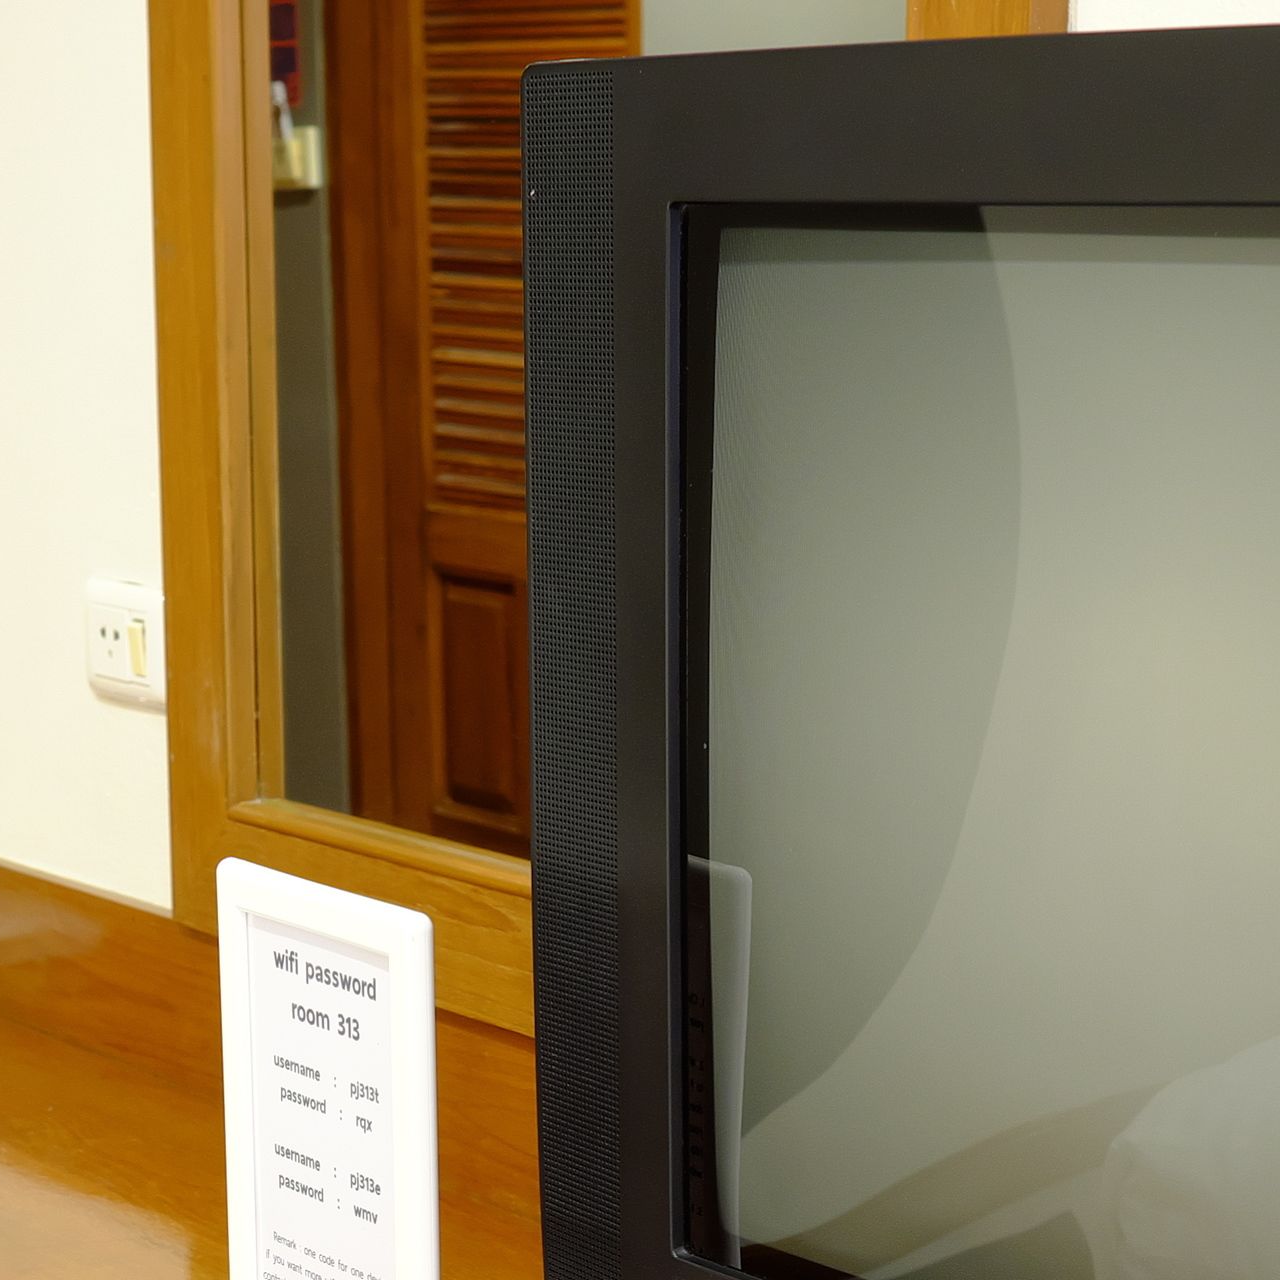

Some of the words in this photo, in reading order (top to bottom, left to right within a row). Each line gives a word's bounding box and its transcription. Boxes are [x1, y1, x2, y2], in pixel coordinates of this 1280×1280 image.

[273, 949, 299, 975] wifi
[305, 960, 377, 1001] password
[291, 1002, 330, 1030] room
[337, 1014, 360, 1041] 313
[273, 1054, 321, 1081] username
[350, 1080, 380, 1104] pj313t
[280, 1085, 327, 1114] password
[355, 1115, 373, 1134] rqx
[274, 1143, 321, 1171] username
[350, 1172, 381, 1195] pj313e
[278, 1173, 324, 1202] password
[353, 1205, 378, 1224] wmv
[273, 1231, 297, 1250] Remark
[304, 1247, 316, 1259] one
[318, 1253, 335, 1267] code
[338, 1259, 348, 1272] for
[350, 1267, 364, 1279] one
[273, 1254, 285, 1265] you
[287, 1261, 302, 1275] want
